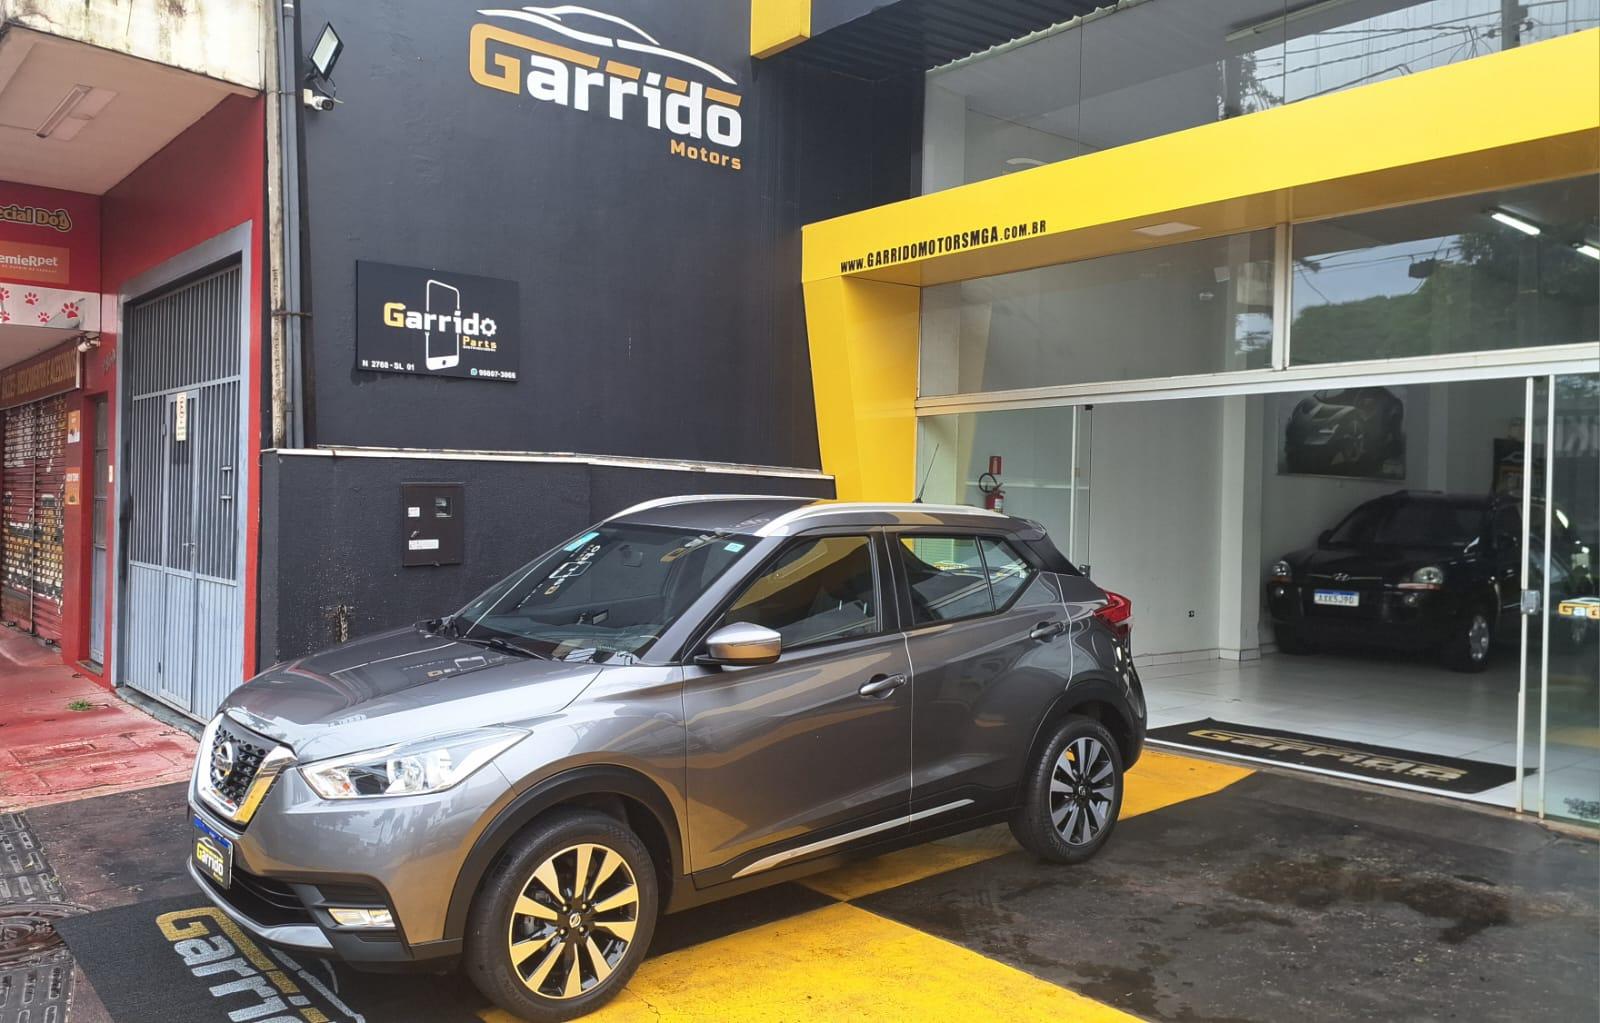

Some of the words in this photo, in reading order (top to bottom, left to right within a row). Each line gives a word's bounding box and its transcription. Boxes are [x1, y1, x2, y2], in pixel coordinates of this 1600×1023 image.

[469, 23, 742, 148] Garrido
[670, 139, 742, 170] Motors
[36, 208, 71, 230] Dog
[383, 302, 497, 337] Garrido
[462, 335, 497, 349] Parts
[156, 907, 312, 1023] Garri
